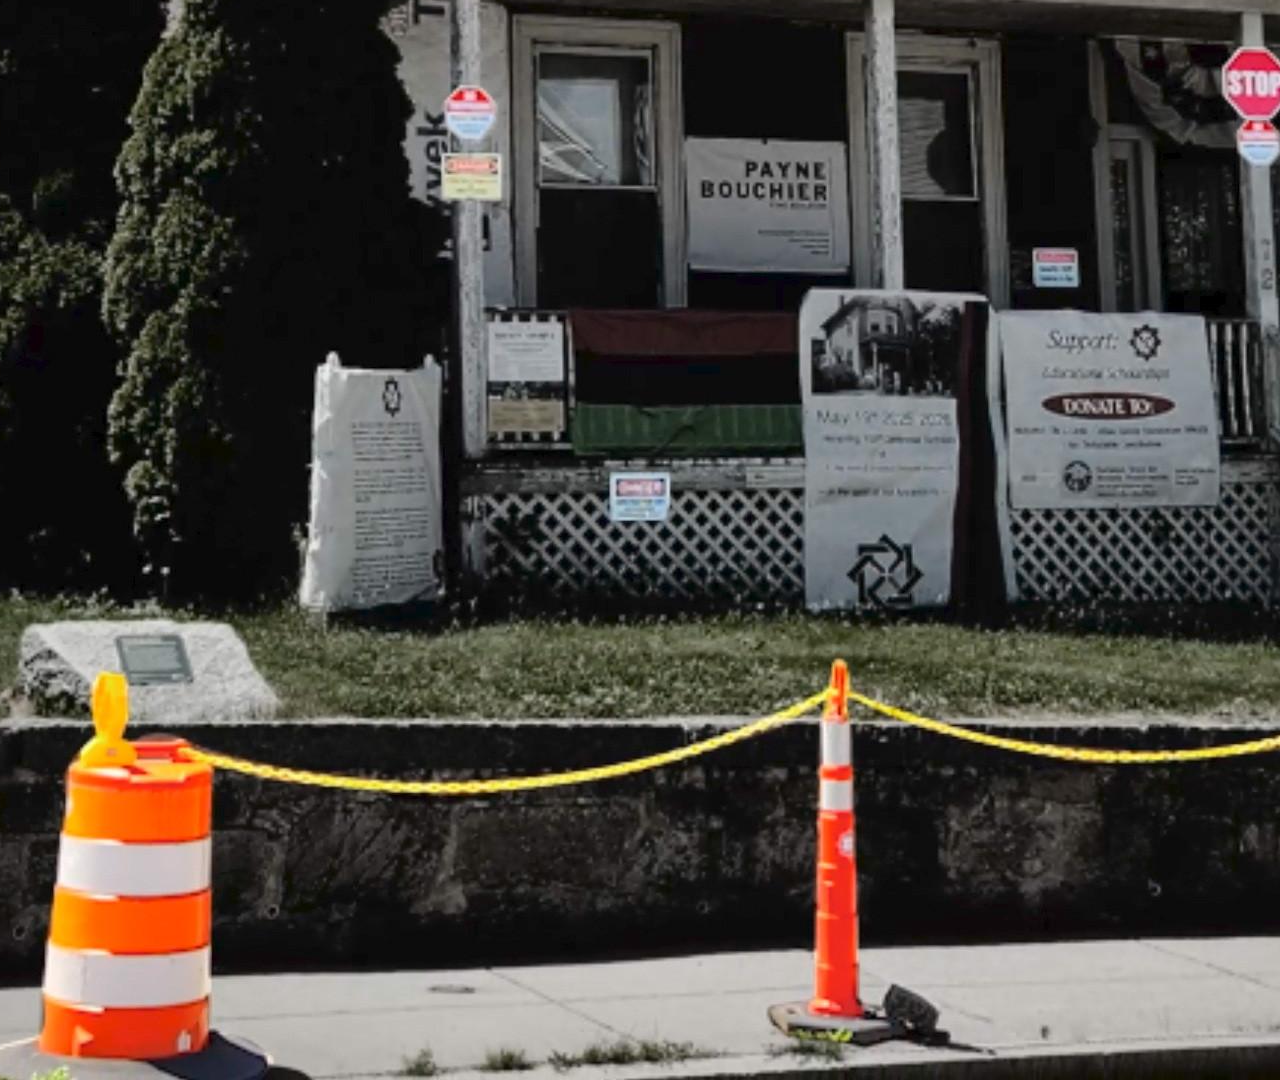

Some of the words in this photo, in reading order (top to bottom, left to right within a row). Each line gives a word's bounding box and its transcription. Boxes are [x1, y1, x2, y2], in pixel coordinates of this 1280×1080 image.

[746, 161, 826, 180] PAYNE
[701, 180, 827, 201] BOUCHIER
[1046, 330, 1119, 355] Support:
[1062, 398, 1125, 415] DONATE
[816, 410, 850, 427] May
